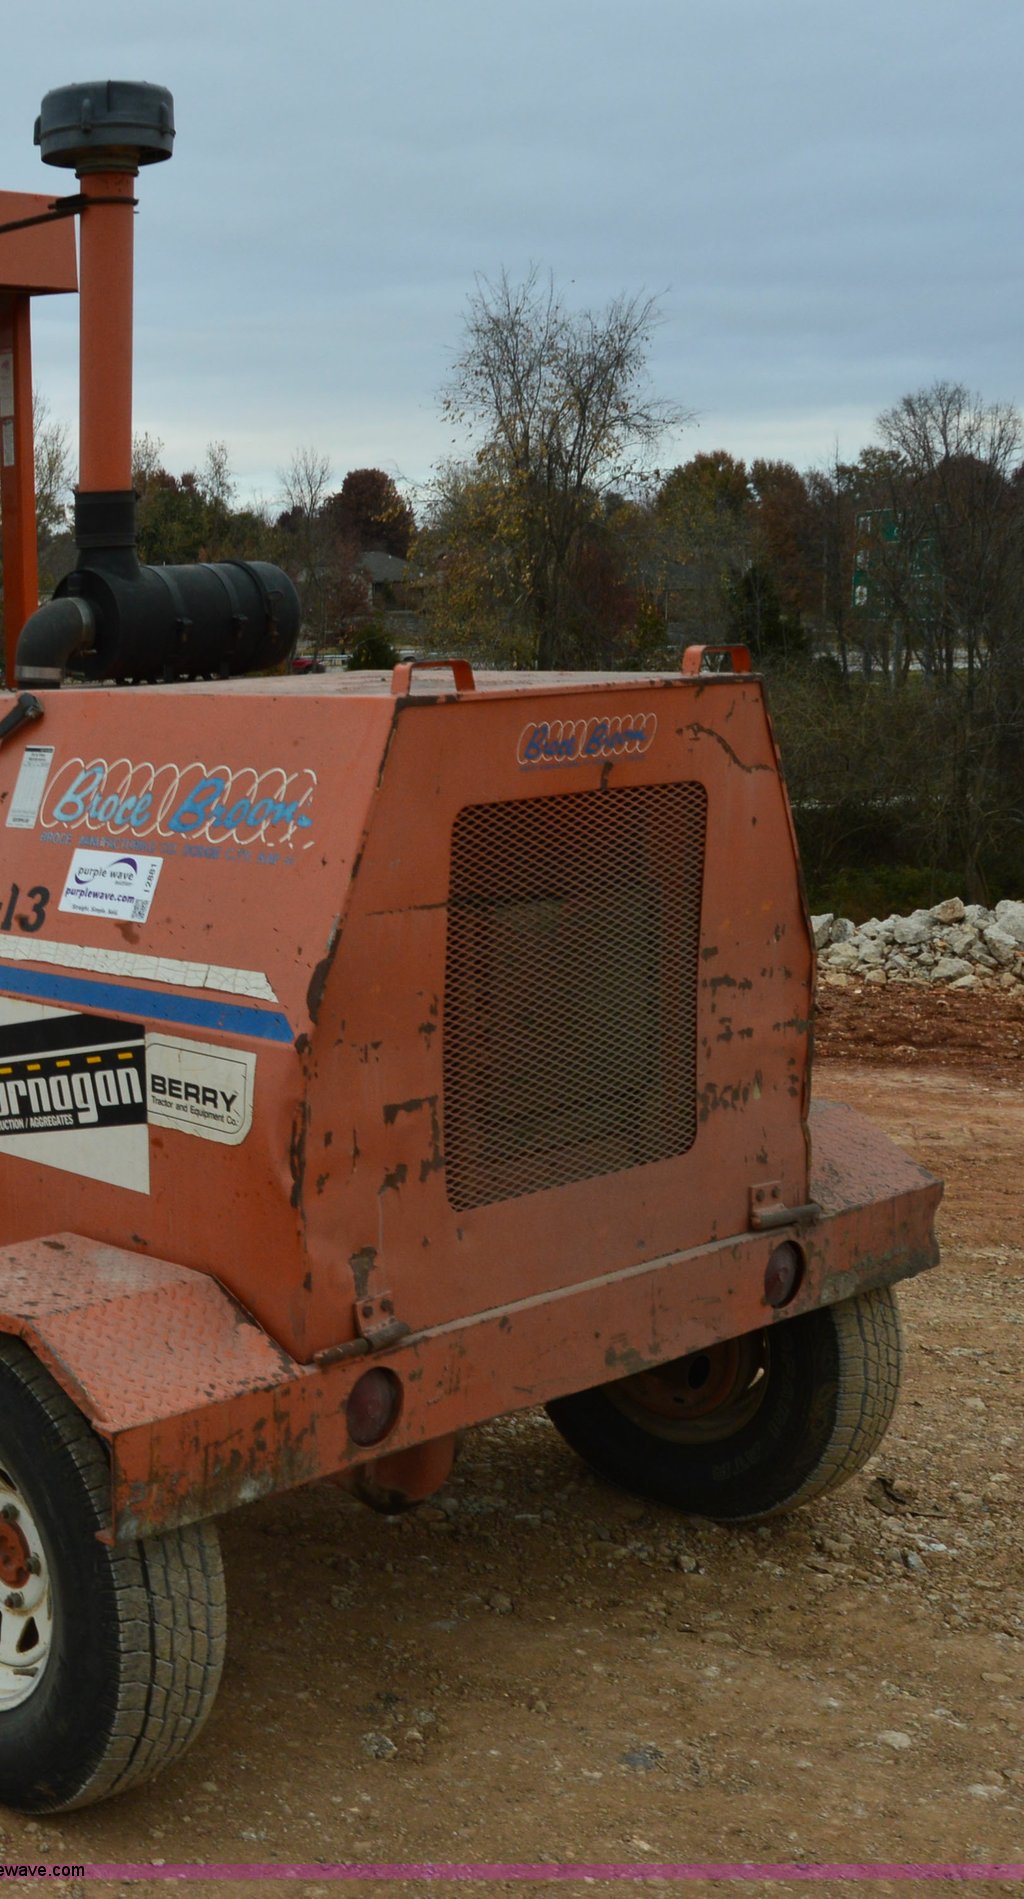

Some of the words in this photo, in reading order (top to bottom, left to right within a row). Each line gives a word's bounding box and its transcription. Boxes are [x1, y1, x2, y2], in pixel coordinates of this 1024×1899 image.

[52, 766, 153, 827] Broce
[77, 866, 107, 878] purple
[110, 870, 134, 881] wave
[65, 887, 135, 904] purplewave.com
[151, 1073, 237, 1112] BERRY
[152, 1095, 173, 1108] Tractor
[176, 1103, 188, 1113] and
[190, 1105, 225, 1122] Equipment
[29, 1114, 74, 1128] AGGREGATES
